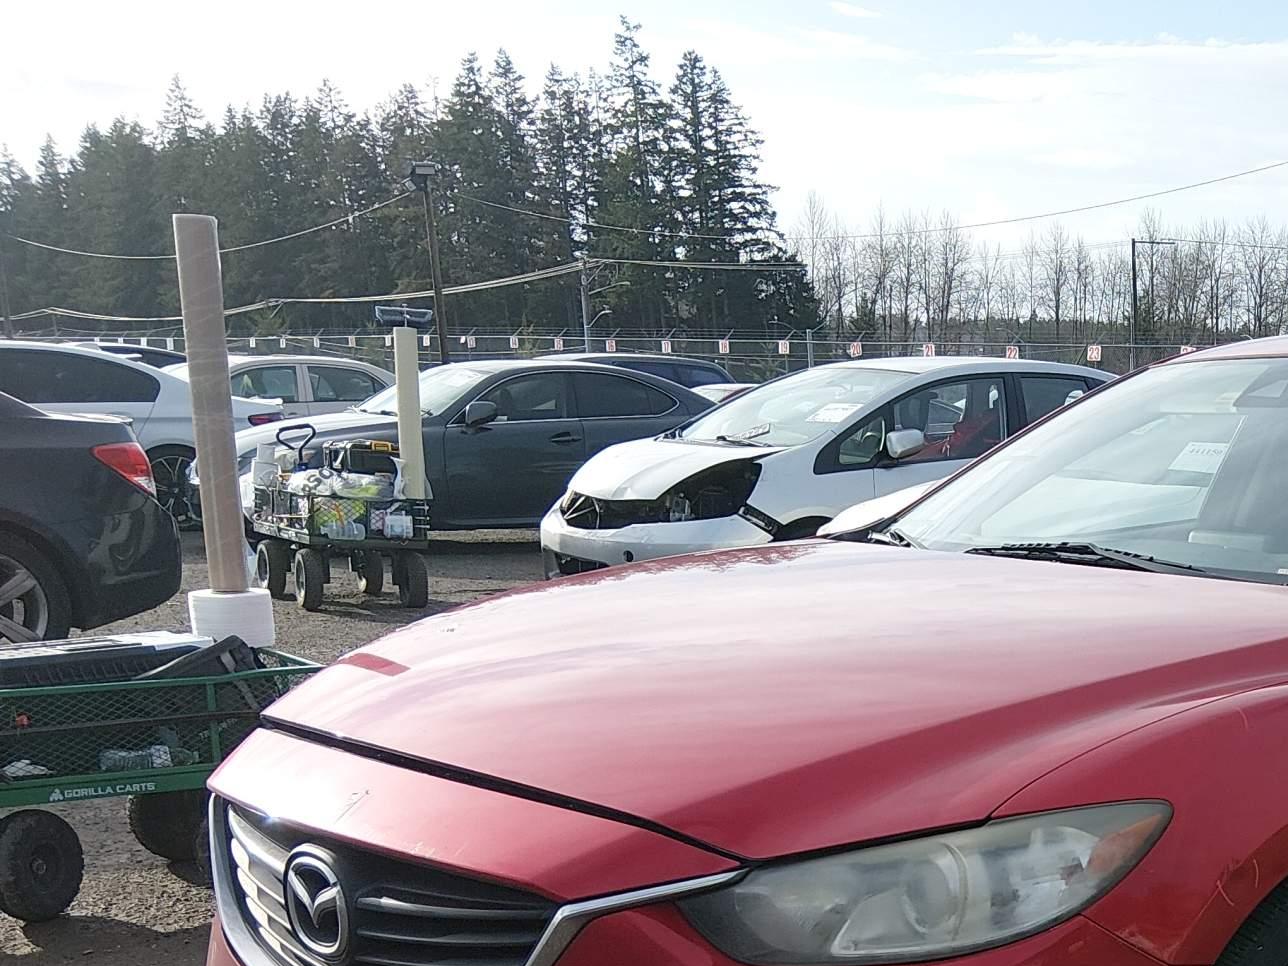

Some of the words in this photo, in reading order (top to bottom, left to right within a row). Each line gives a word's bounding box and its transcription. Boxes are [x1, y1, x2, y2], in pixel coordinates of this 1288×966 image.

[663, 341, 671, 352] 17
[720, 341, 728, 353] 18
[780, 342, 789, 353] 19
[852, 342, 861, 355] 20
[925, 344, 934, 356] 21
[1007, 346, 1017, 358] 22
[1088, 347, 1099, 359] 23
[64, 786, 114, 798] GORILLA
[116, 782, 157, 793] CARTS
